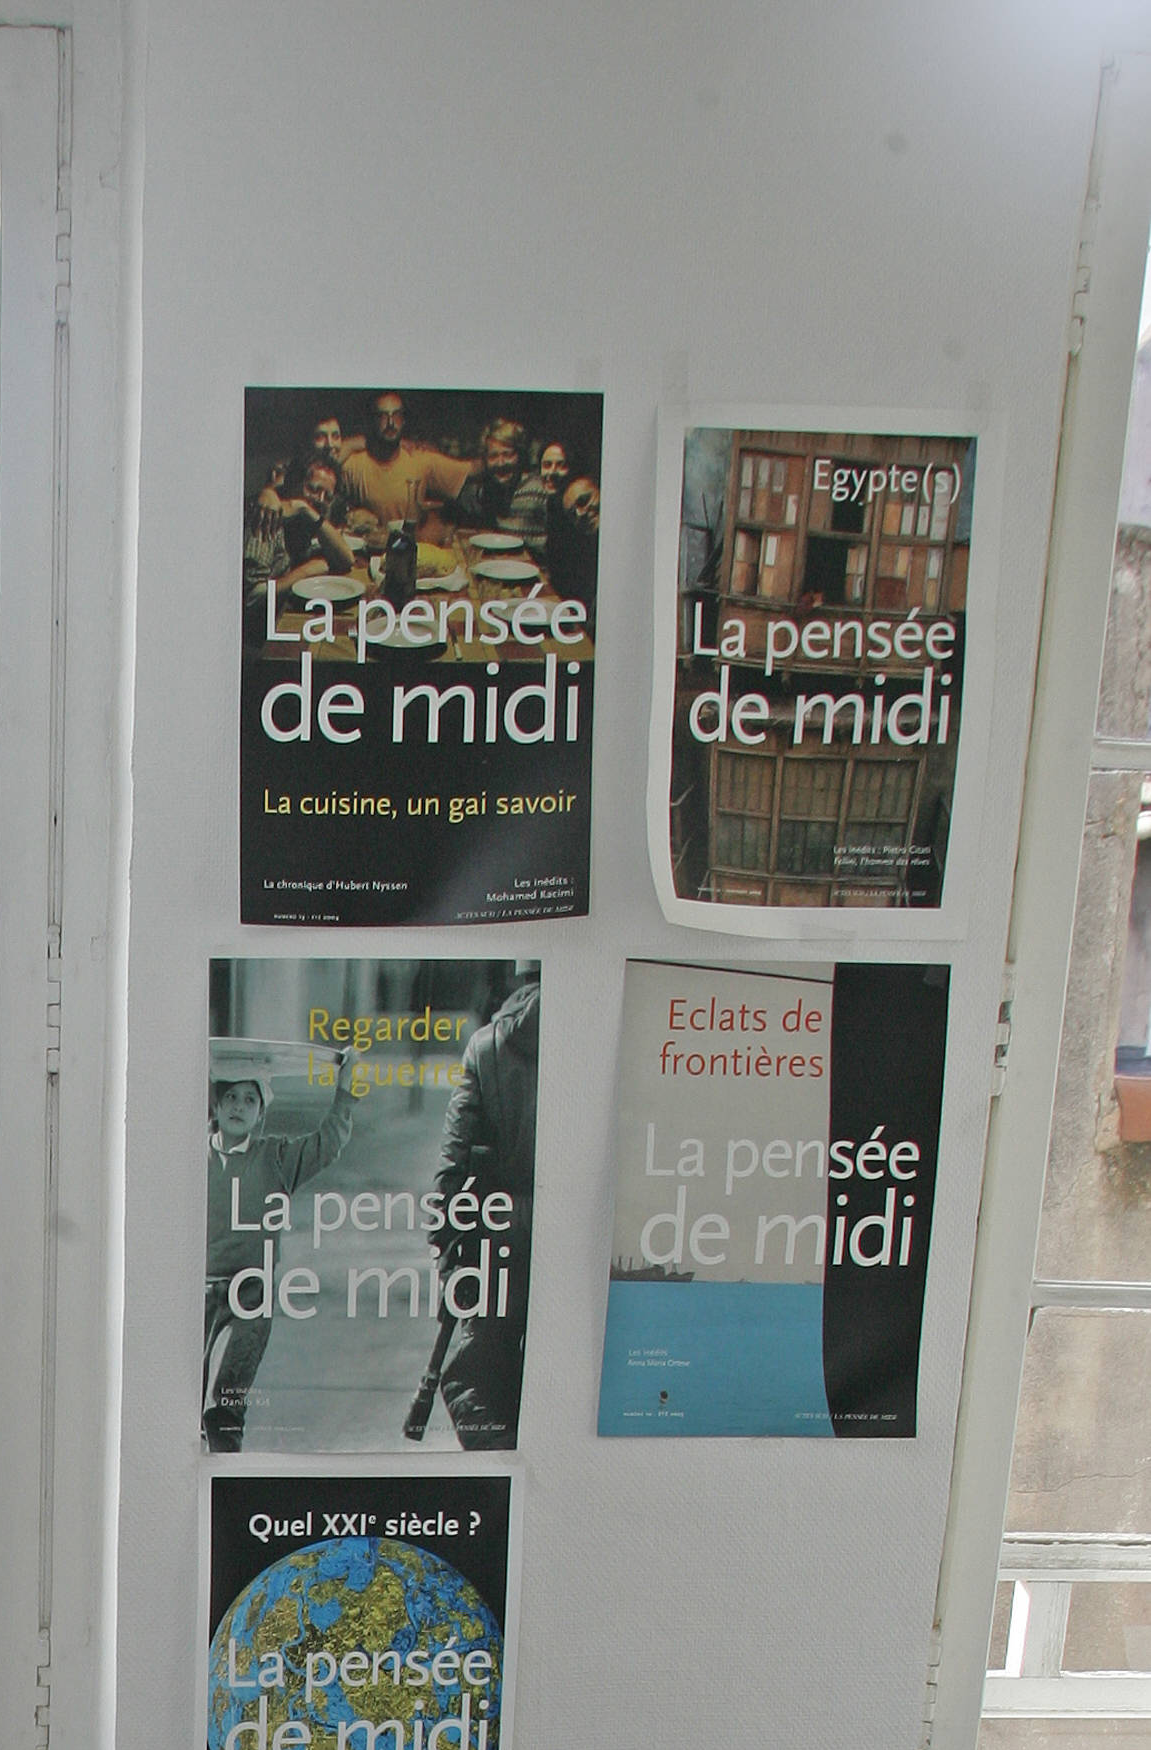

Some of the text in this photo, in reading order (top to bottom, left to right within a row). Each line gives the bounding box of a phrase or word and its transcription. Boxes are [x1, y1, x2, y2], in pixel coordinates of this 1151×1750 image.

[813, 458, 961, 503] Egypte(s)
[265, 579, 588, 664] La pensée
[693, 601, 955, 676] La pensée
[260, 651, 581, 744] de midi
[688, 665, 952, 745] de midi
[263, 788, 577, 824] La cuisine, un gai savoir
[263, 879, 274, 889] La
[486, 889, 538, 902] Mohamed
[514, 878, 531, 889] Les
[308, 1006, 468, 1053] Regarder
[668, 996, 823, 1033] Eclats de
[307, 1053, 466, 1097] la guerre
[660, 1040, 824, 1079] frontières
[645, 1122, 921, 1195] La pensée
[230, 1177, 514, 1249] La pensée
[640, 1184, 917, 1267] de midi
[227, 1239, 511, 1320] de midi
[249, 1512, 313, 1543] Quel
[385, 1511, 459, 1536] siècle
[469, 1512, 481, 1537] ?
[228, 1637, 492, 1703] La pensée
